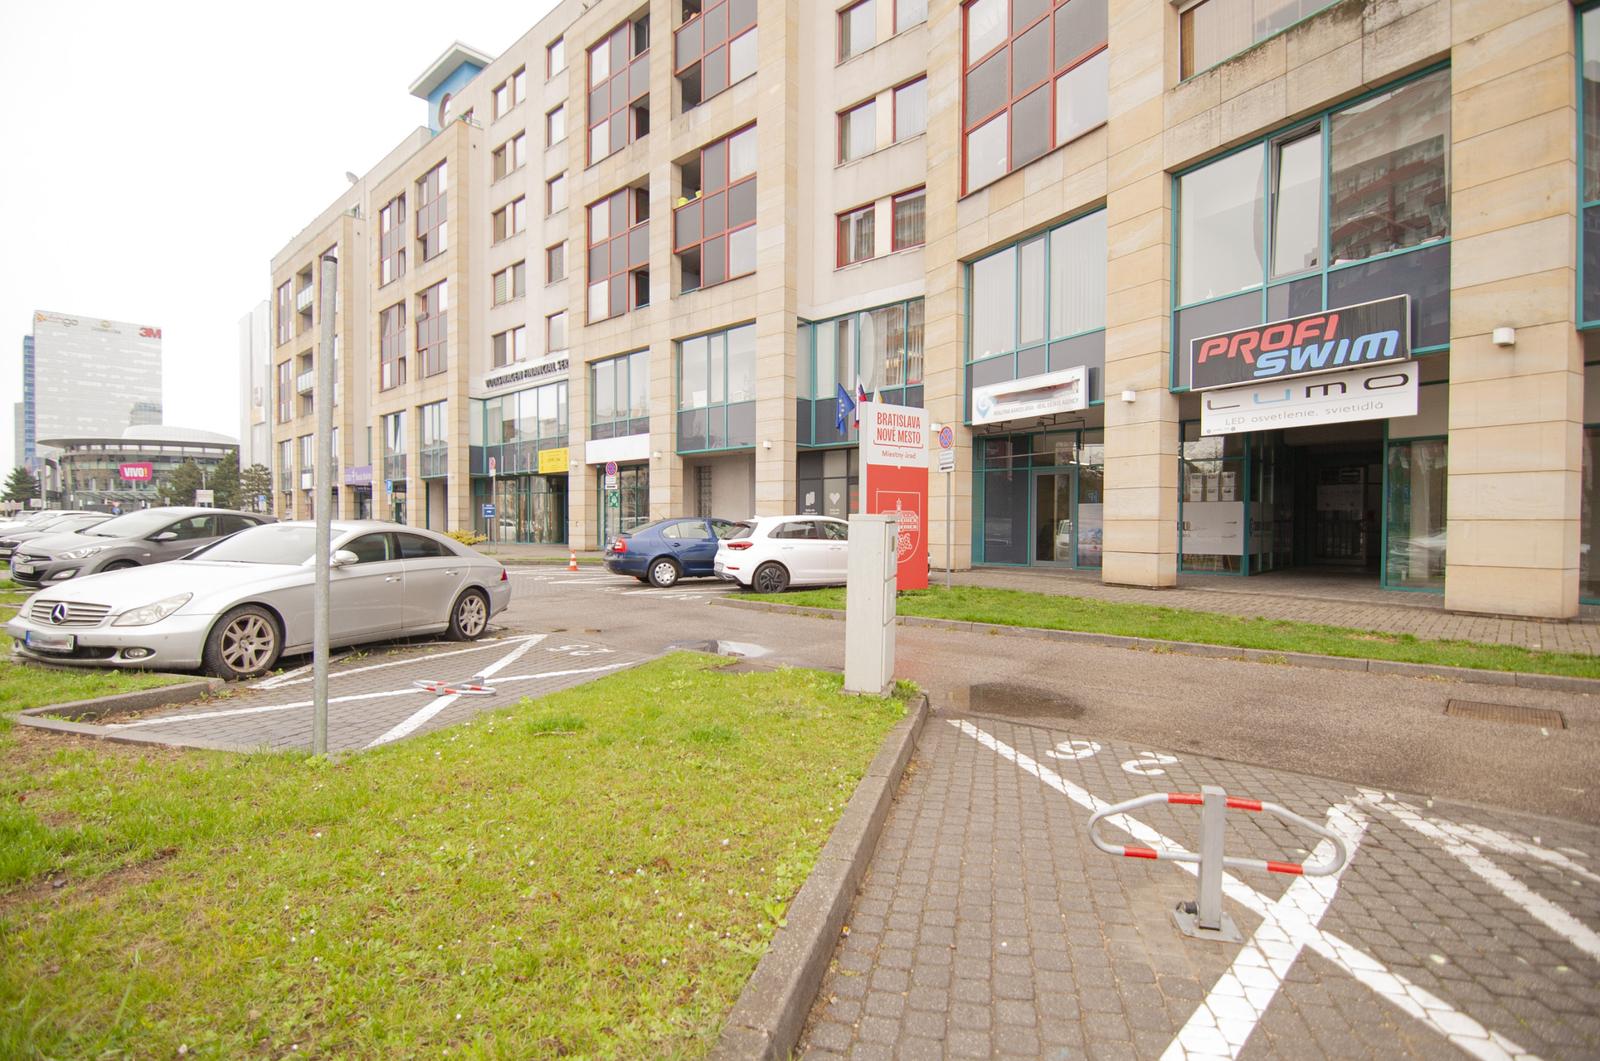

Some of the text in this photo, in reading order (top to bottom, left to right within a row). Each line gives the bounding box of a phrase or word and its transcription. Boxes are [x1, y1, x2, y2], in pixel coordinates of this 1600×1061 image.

[139, 326, 162, 339] 3M
[1197, 313, 1340, 364] PROFI
[1253, 329, 1399, 378] SWIM
[877, 412, 921, 429] BRATISLAVA
[1224, 415, 1245, 426] LED
[877, 426, 921, 444] NOVÉ MESTO
[881, 450, 904, 459] Miestny
[124, 466, 148, 478] VIVO!
